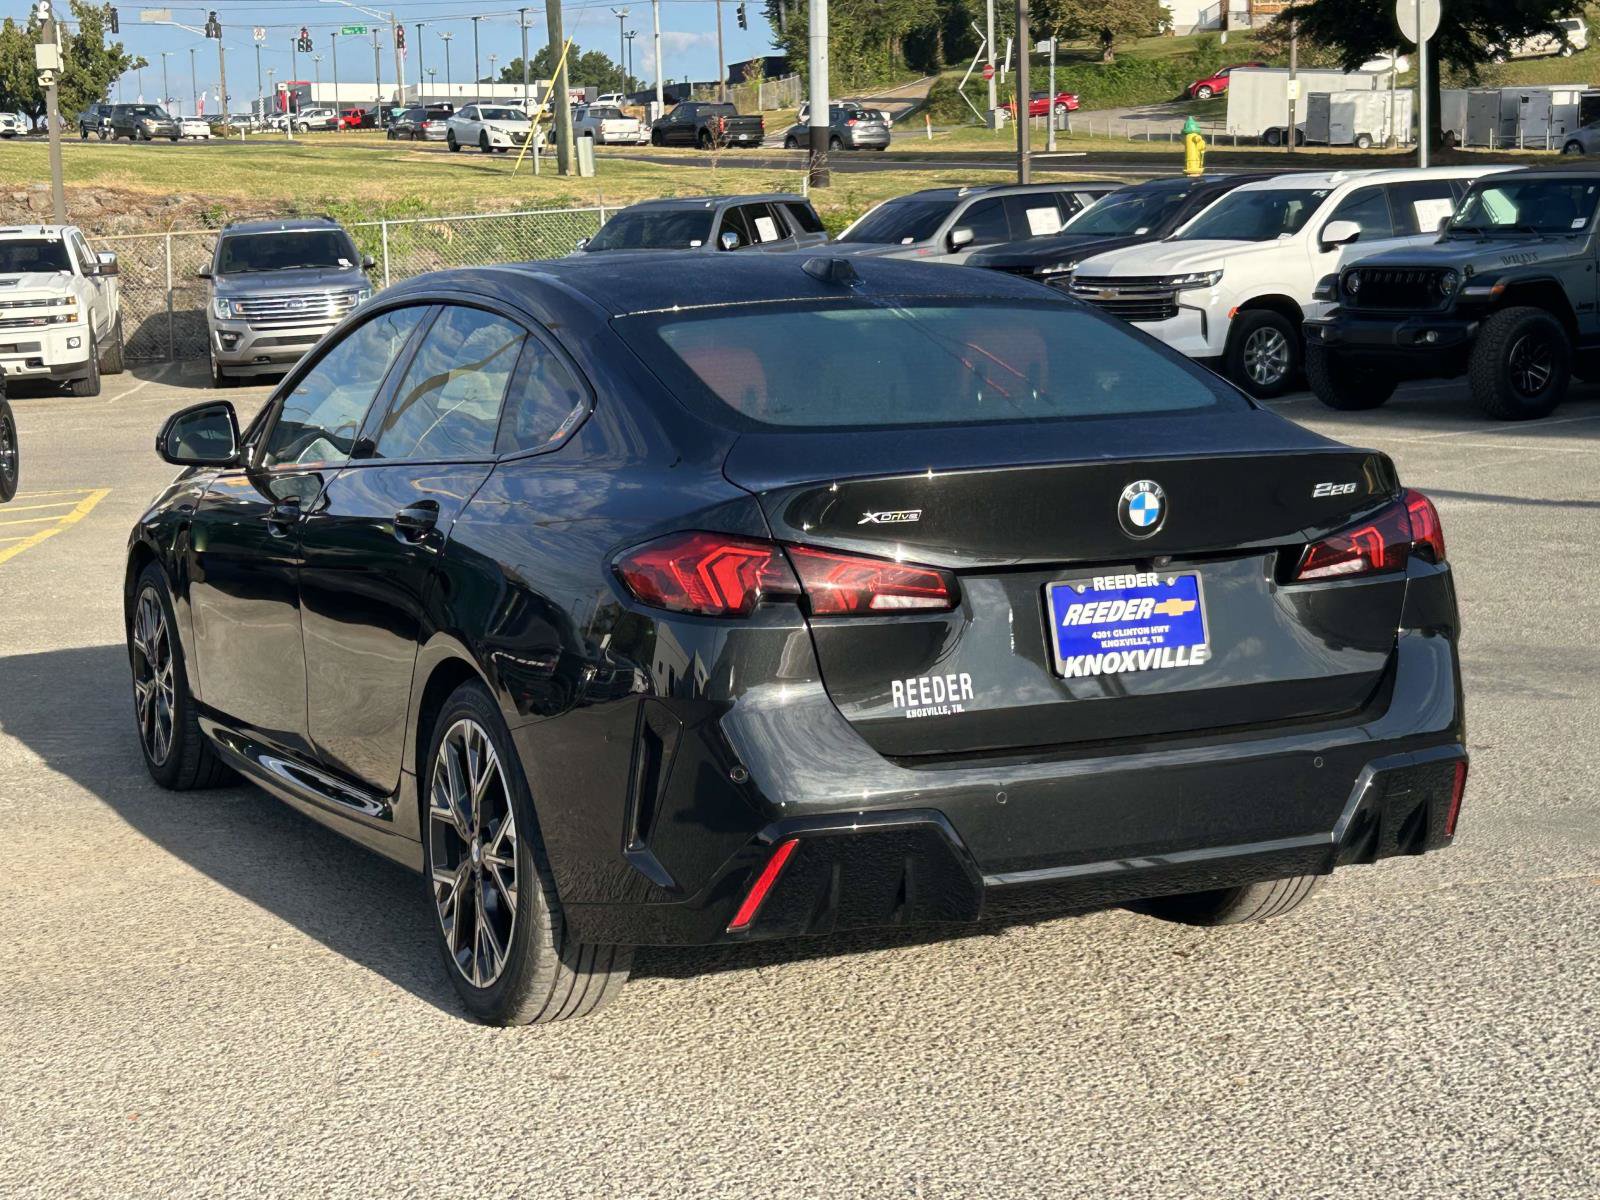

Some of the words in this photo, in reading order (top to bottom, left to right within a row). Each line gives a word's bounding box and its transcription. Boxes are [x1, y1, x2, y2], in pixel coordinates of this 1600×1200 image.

[1499, 251, 1539, 265] WILLYS
[1124, 482, 1165, 501] BMW
[1313, 482, 1357, 498] 228
[1092, 572, 1160, 592] REEDER
[1062, 597, 1157, 627] REEDER
[1112, 626, 1150, 638] CLINTON
[1150, 624, 1170, 634] HWY
[1064, 643, 1208, 679] KNOXVILLE
[891, 672, 974, 708] REEDER
[906, 705, 951, 719] KNOXVILLE,
